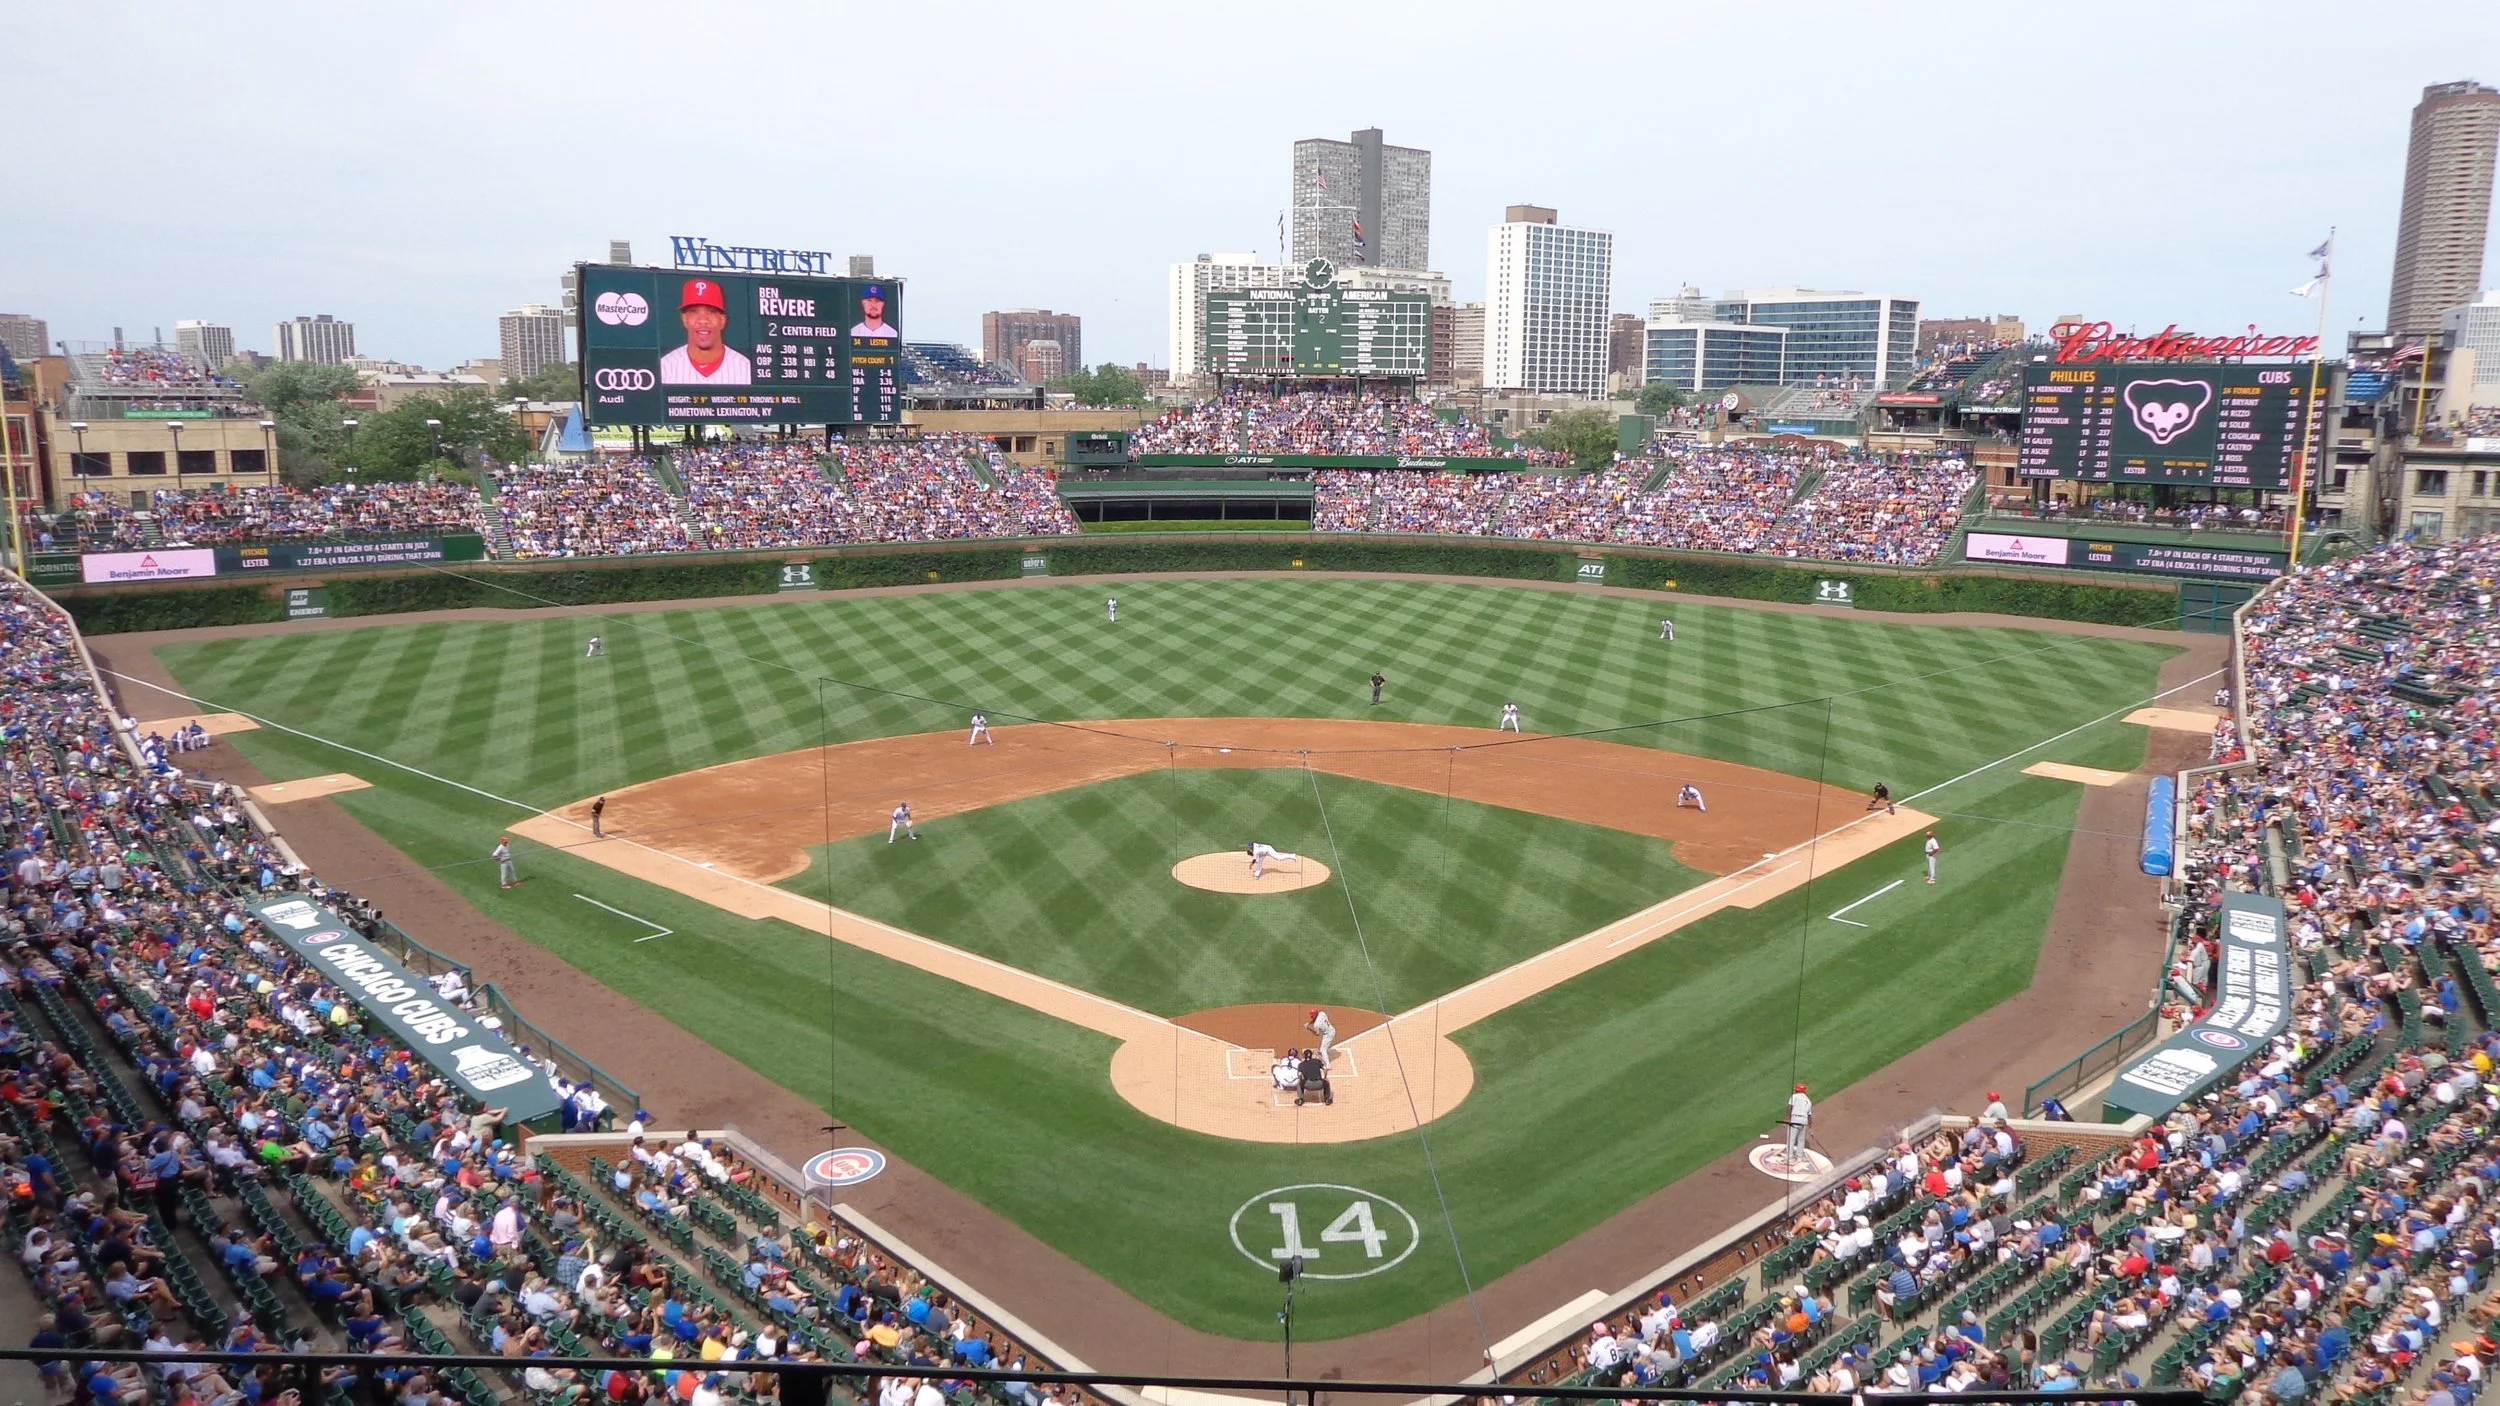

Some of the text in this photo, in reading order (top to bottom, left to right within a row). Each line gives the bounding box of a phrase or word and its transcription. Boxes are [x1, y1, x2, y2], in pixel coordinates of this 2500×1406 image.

[759, 287, 779, 299] BEN
[1250, 290, 1296, 300] NATIONAL
[1342, 291, 1388, 300] AMERICAN
[597, 304, 646, 314] MasterCard
[759, 299, 816, 317] REVERE
[768, 322, 837, 338] 2 CENTER FIELD
[2049, 321, 2319, 364] Budweiser
[756, 344, 832, 355] AVG .300 HR 1
[756, 357, 772, 366] OBP
[803, 358, 816, 367] RBI
[756, 369, 772, 378] SLG
[804, 370, 810, 379] R
[2050, 371, 2096, 382] PHILLIES
[2258, 371, 2291, 384] CUBS
[599, 395, 624, 403] Audi
[669, 407, 772, 418] HOMETOWN: LEXINGTON, KY
[1237, 456, 1257, 464] ATI
[1397, 457, 1446, 468] Budweiser
[333, 546, 343, 554] IN
[344, 545, 362, 553] EACH
[364, 544, 374, 552] OF
[375, 544, 380, 552] 4
[380, 543, 404, 551] STARTS
[405, 542, 413, 550] IN
[414, 542, 429, 551] JULY
[313, 557, 327, 566] ERA
[378, 553, 404, 562] DURING
[405, 552, 421, 560] THAT
[423, 551, 441, 559] SPAN
[1985, 549, 2045, 560] Benjamin Moore
[2088, 553, 2112, 562] LESTER
[2218, 554, 2243, 562] STARTS
[2253, 557, 2271, 565] JULY
[32, 562, 81, 573] HORNITOS
[242, 558, 269, 568] LESTER
[110, 567, 187, 580] Benjamin Moore
[1578, 564, 1604, 575] ATI
[2213, 564, 2241, 573] DURING
[2242, 566, 2260, 574] THAT
[2262, 567, 2282, 576] SPAN
[290, 594, 308, 602] AEP
[289, 607, 325, 616] ENERGY
[319, 943, 469, 1044] CHICAGO CUBS
[2205, 994, 2251, 1029] WELCOME
[1268, 1200, 1388, 1260] 14
